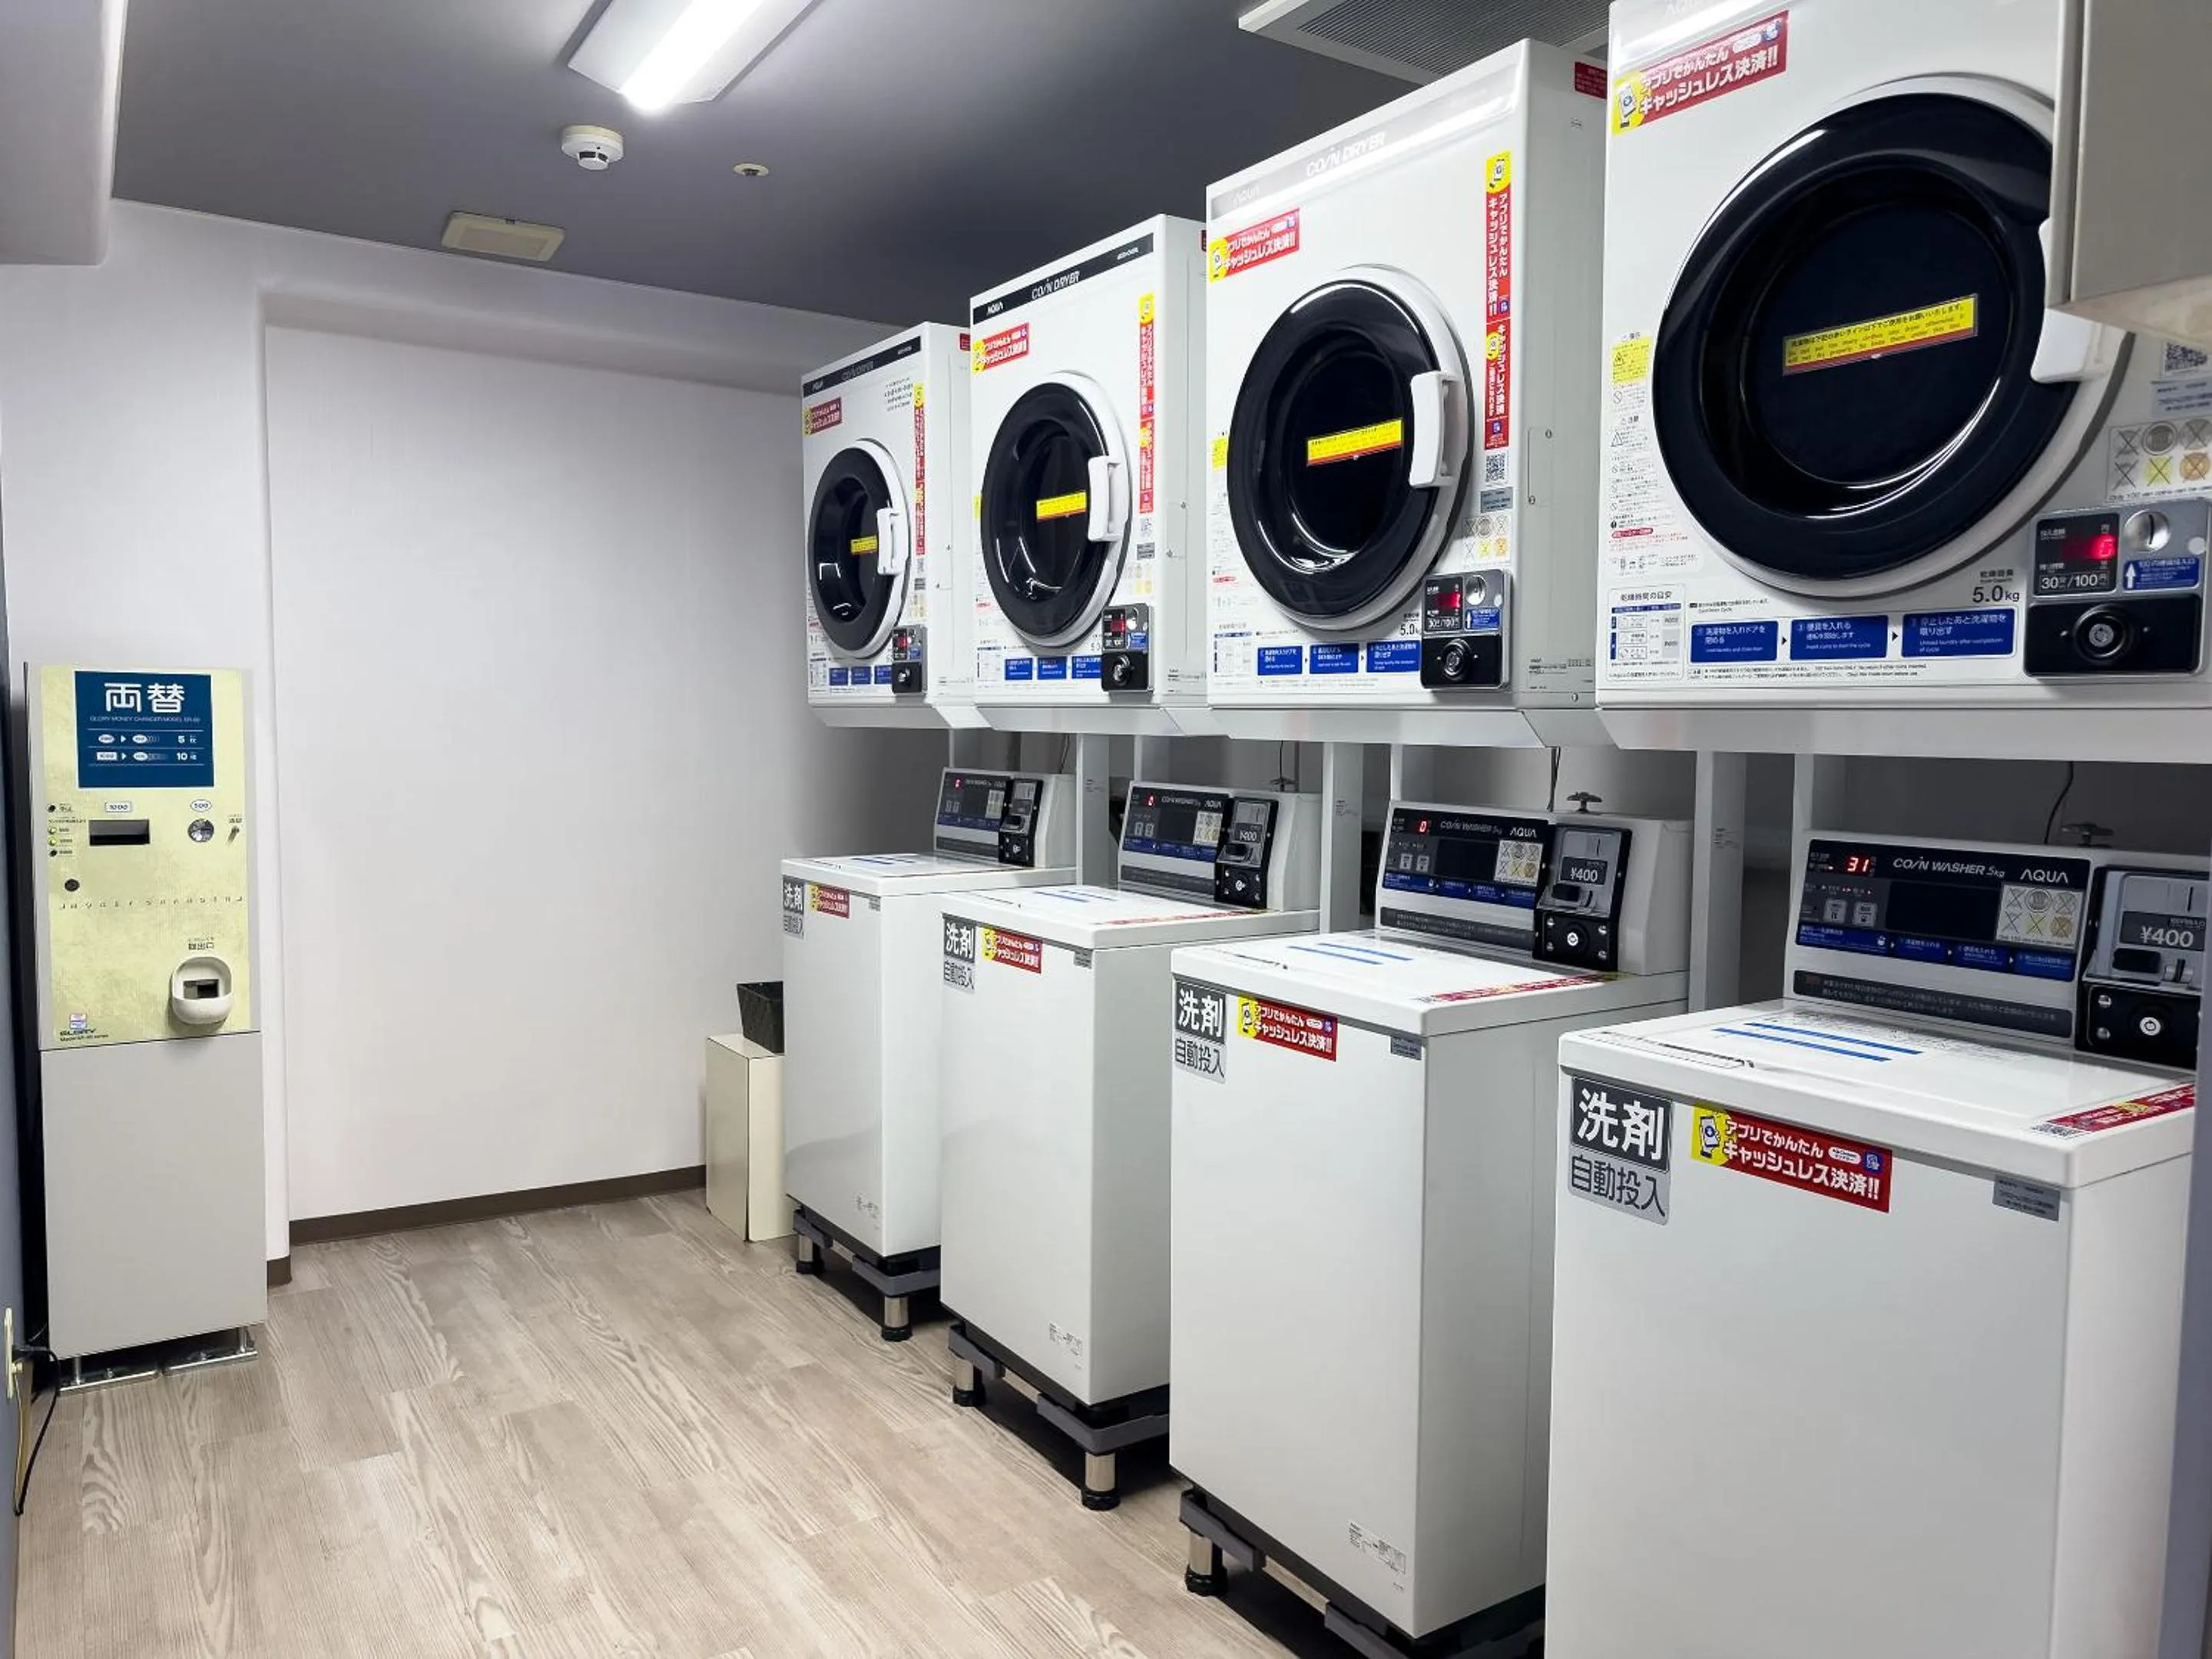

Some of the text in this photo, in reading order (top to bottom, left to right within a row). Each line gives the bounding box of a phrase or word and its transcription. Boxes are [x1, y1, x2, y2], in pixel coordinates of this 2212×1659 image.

[1640, 46, 1779, 114] キャッシュレス決済!!
[1641, 46, 1728, 93] アプリでかんたん
[1972, 584, 2020, 604] 5.0kg
[104, 682, 185, 713] 両替
[177, 735, 185, 744] 5
[177, 752, 188, 761] 10
[1419, 820, 1427, 833] 0
[1509, 826, 1537, 838] AQUA
[1570, 866, 1598, 882] ¥400
[1847, 856, 1869, 873] 31
[1931, 861, 1985, 876] WASHER
[2020, 869, 2069, 885] AQUA
[946, 922, 975, 959] 洗剤
[2141, 925, 2194, 948] ¥400
[1177, 988, 1224, 1038] 洗剤
[1176, 1038, 1225, 1079] 自動投入
[1577, 1087, 1664, 1161] 洗剤
[1726, 1118, 1824, 1159] アプリでかんたん
[1723, 1141, 1880, 1200] キャッシュレス決済!!
[1571, 1154, 1666, 1217] 自動投入
